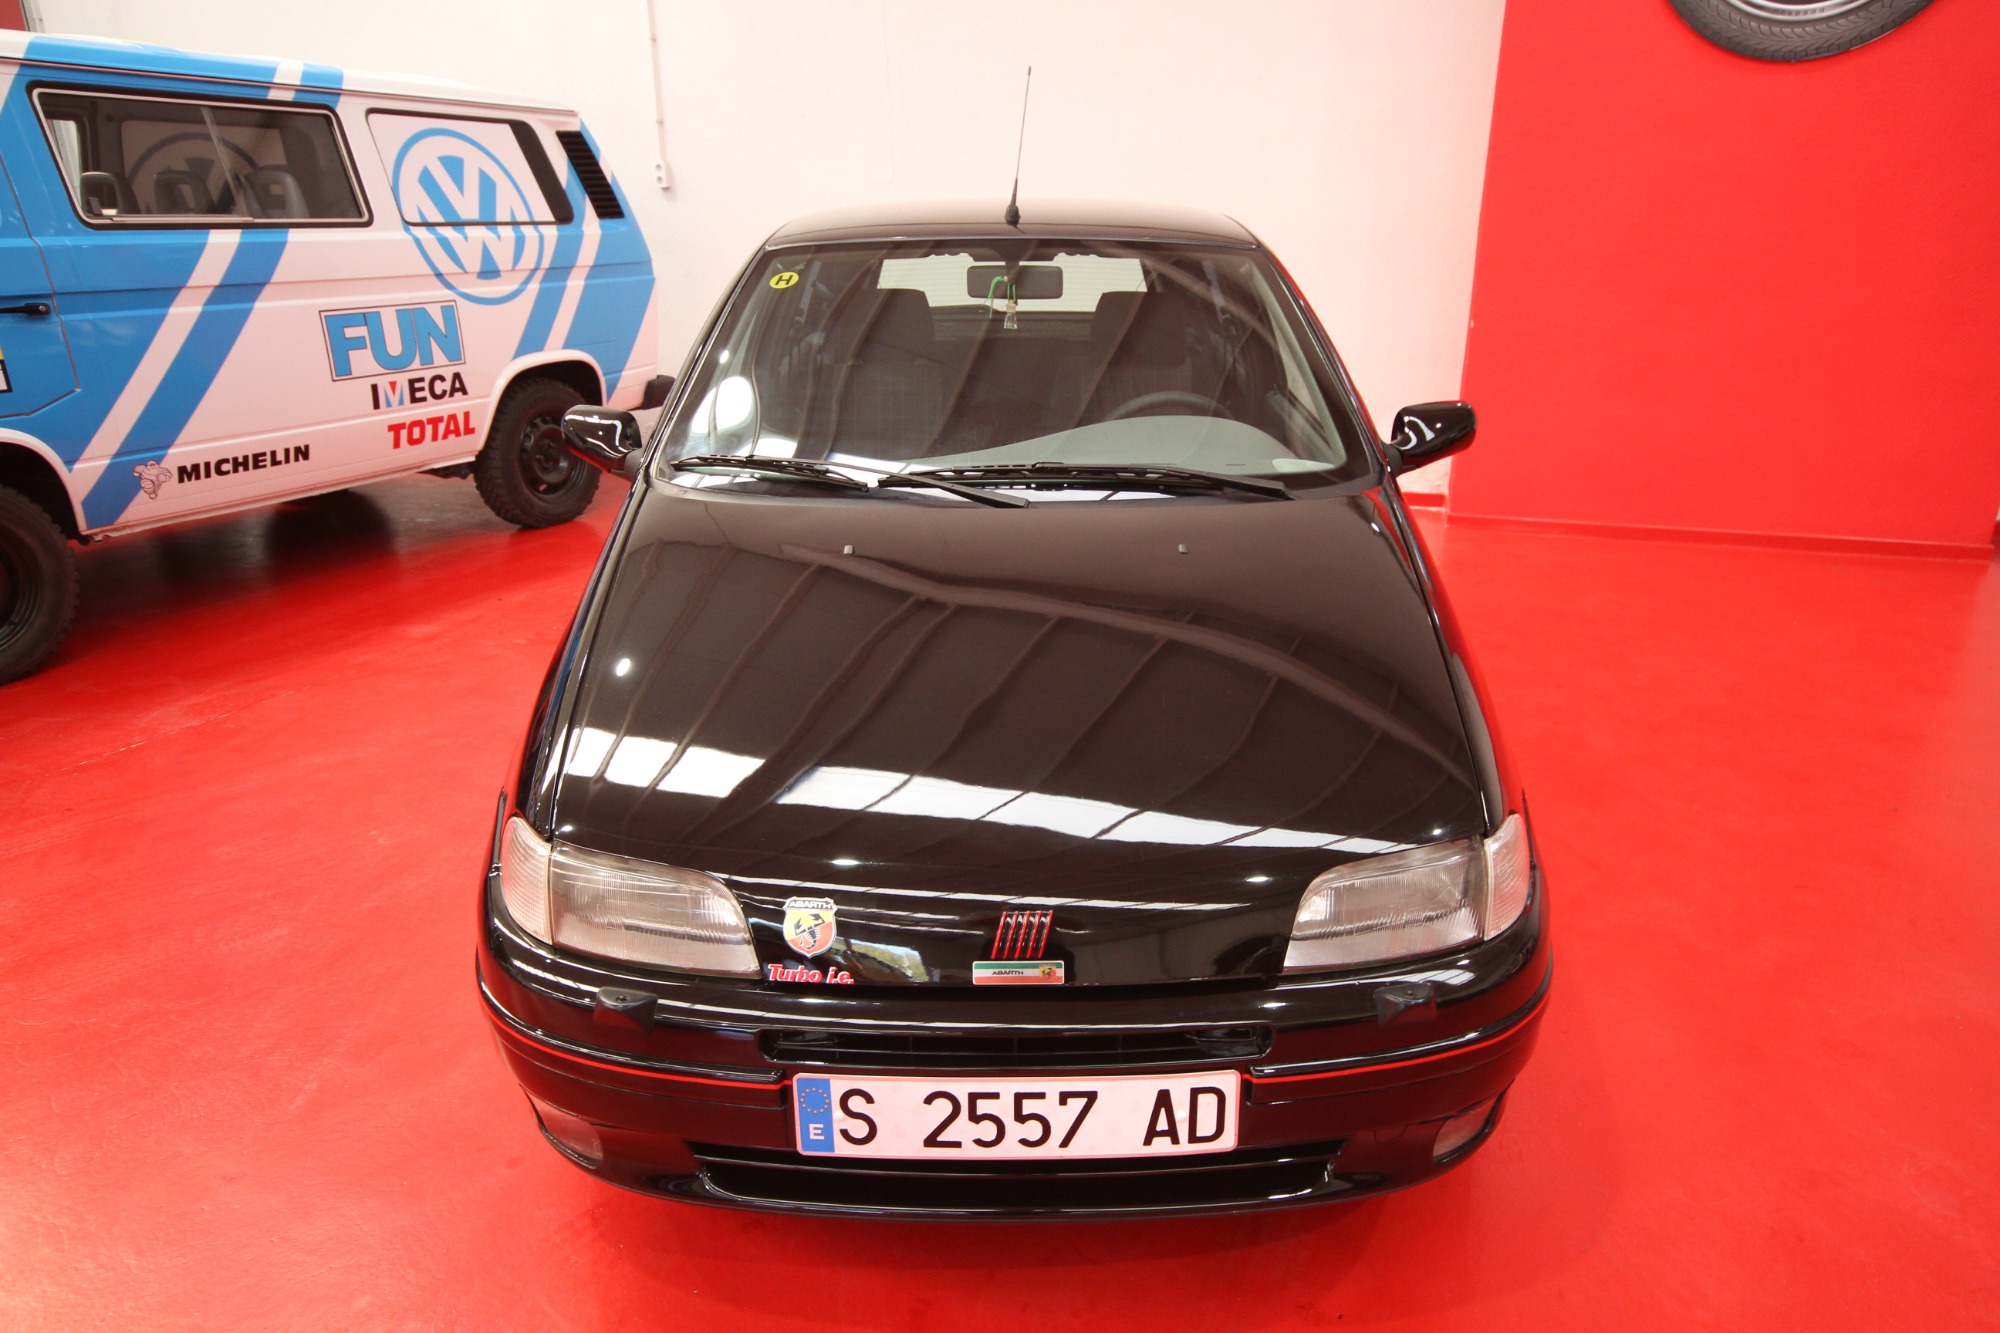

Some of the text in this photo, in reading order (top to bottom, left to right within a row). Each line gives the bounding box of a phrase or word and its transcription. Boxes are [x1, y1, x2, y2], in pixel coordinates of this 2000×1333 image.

[399, 136, 539, 297] VW
[775, 274, 794, 286] H
[324, 304, 463, 377] FUN
[370, 371, 469, 411] IMECA
[387, 410, 476, 450] TOTAL
[177, 444, 311, 484] MICHELIN
[788, 899, 832, 910] ABARTH
[767, 963, 855, 985] Turbo i.e.
[808, 1123, 825, 1140] E
[838, 1085, 1227, 1149] S 2557 AD
